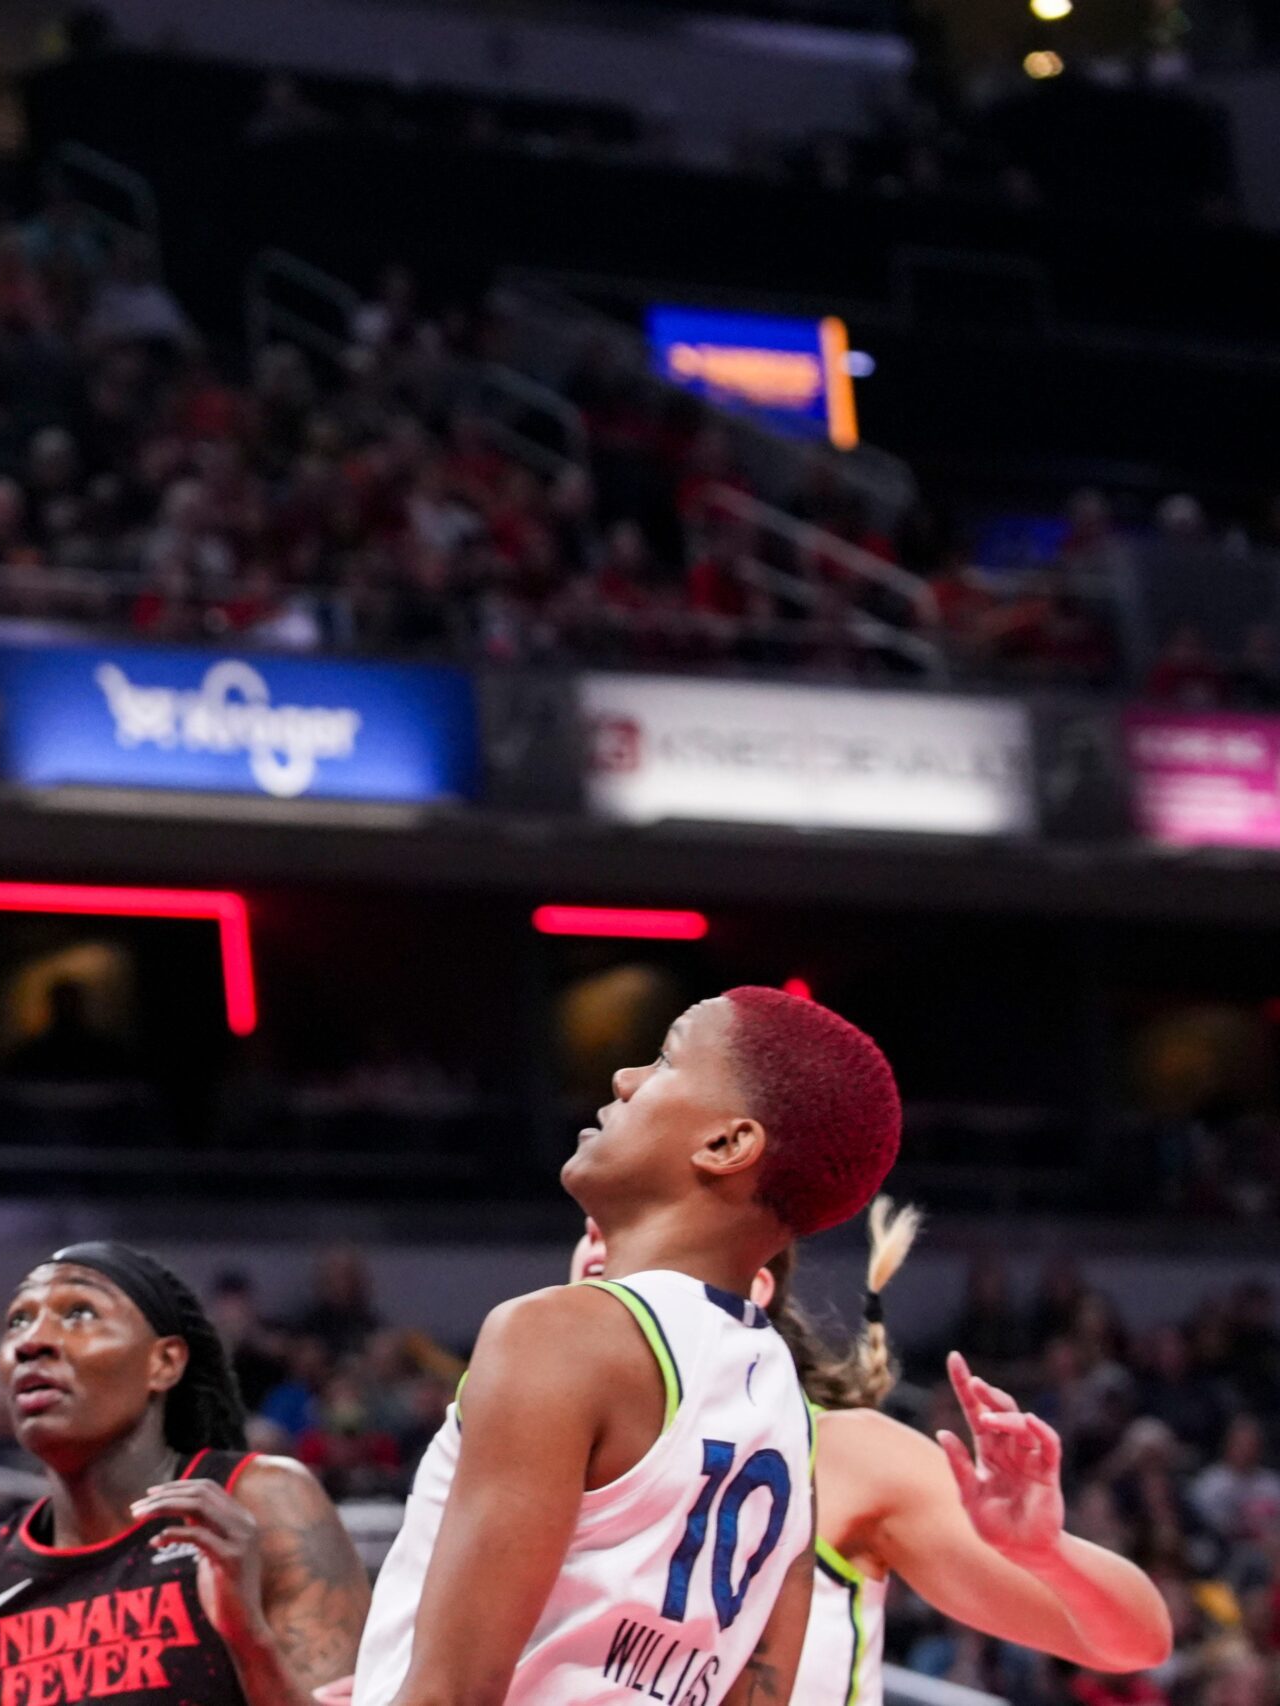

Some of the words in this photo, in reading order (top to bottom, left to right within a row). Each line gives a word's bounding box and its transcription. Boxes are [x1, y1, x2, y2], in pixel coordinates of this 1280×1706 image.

[660, 1438, 791, 1633] 10
[0, 1637, 170, 1706] FEVER
[602, 1618, 720, 1706] WILLIS
